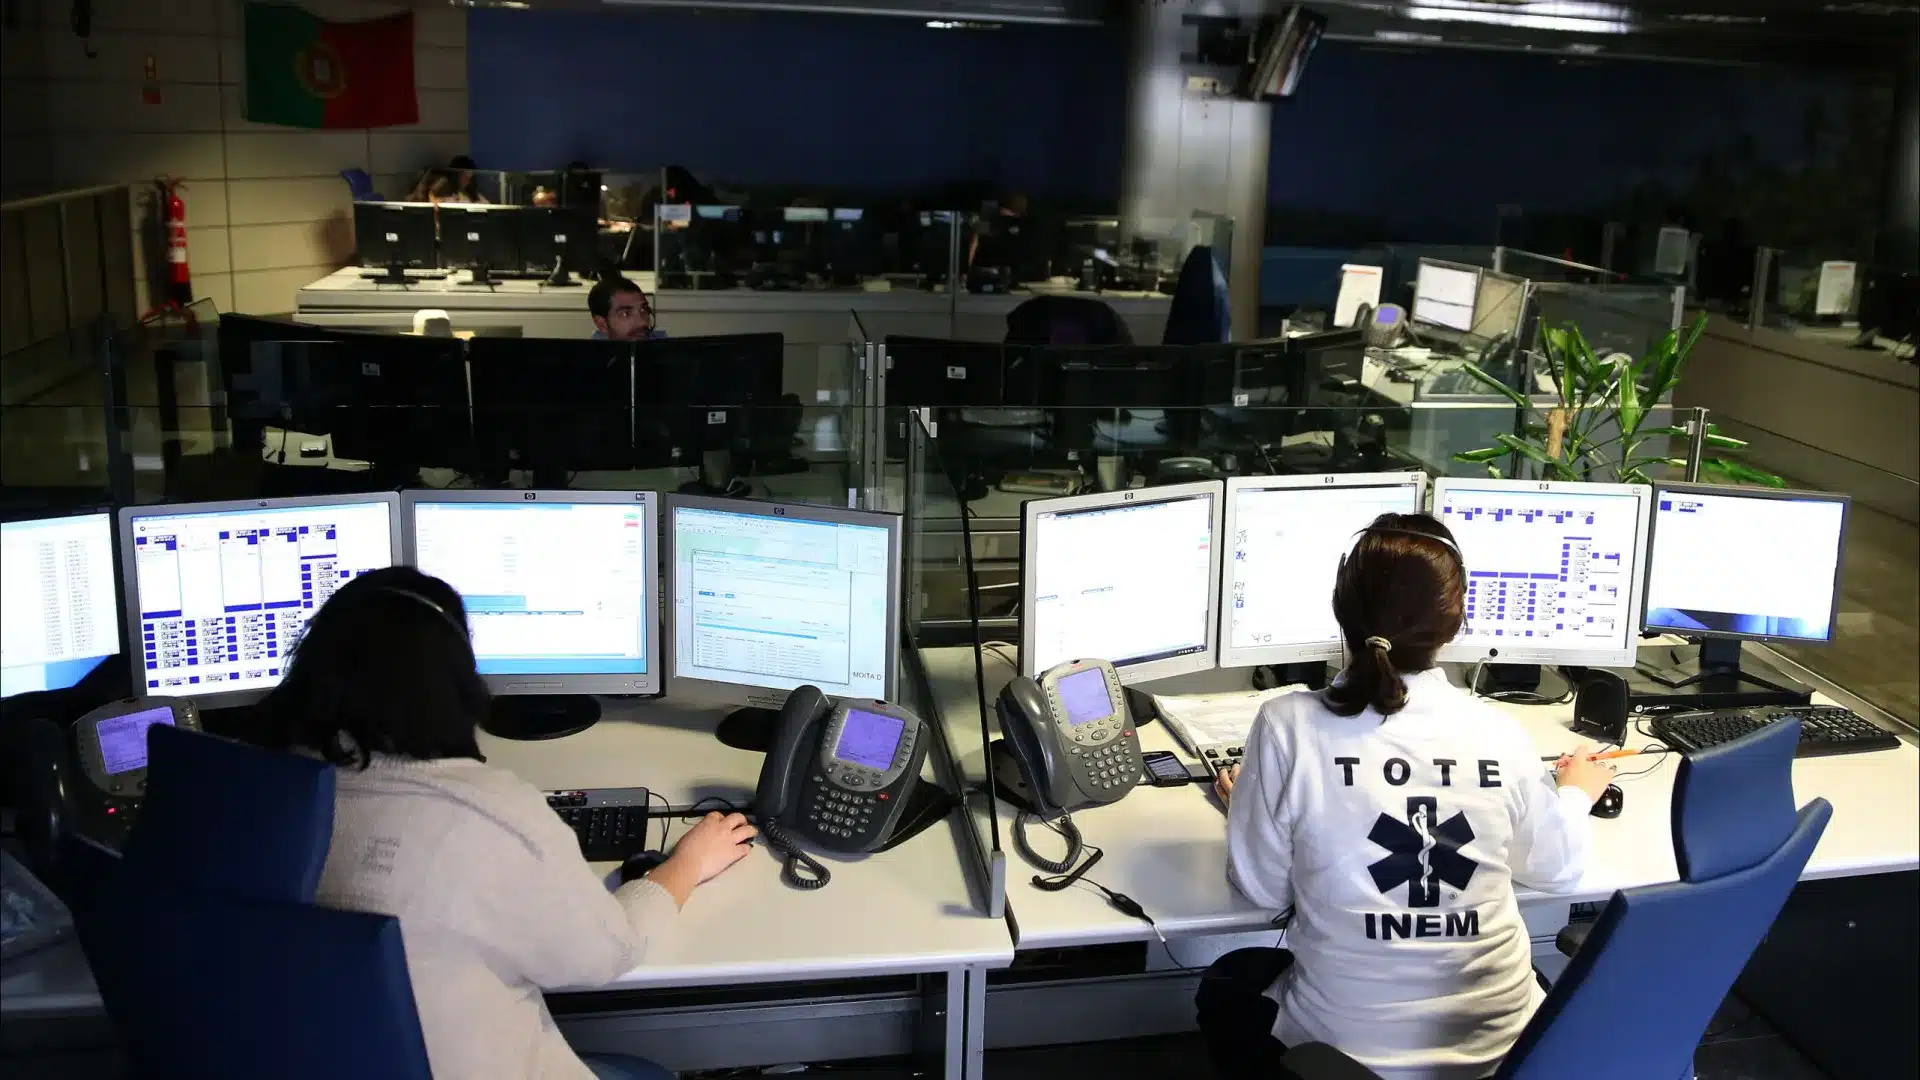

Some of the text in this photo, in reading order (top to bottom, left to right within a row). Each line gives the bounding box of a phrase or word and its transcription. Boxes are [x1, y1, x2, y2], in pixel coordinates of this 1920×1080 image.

[853, 671, 875, 680] MOITA
[1334, 756, 1502, 788] TOTE
[1365, 910, 1479, 940] INEM
